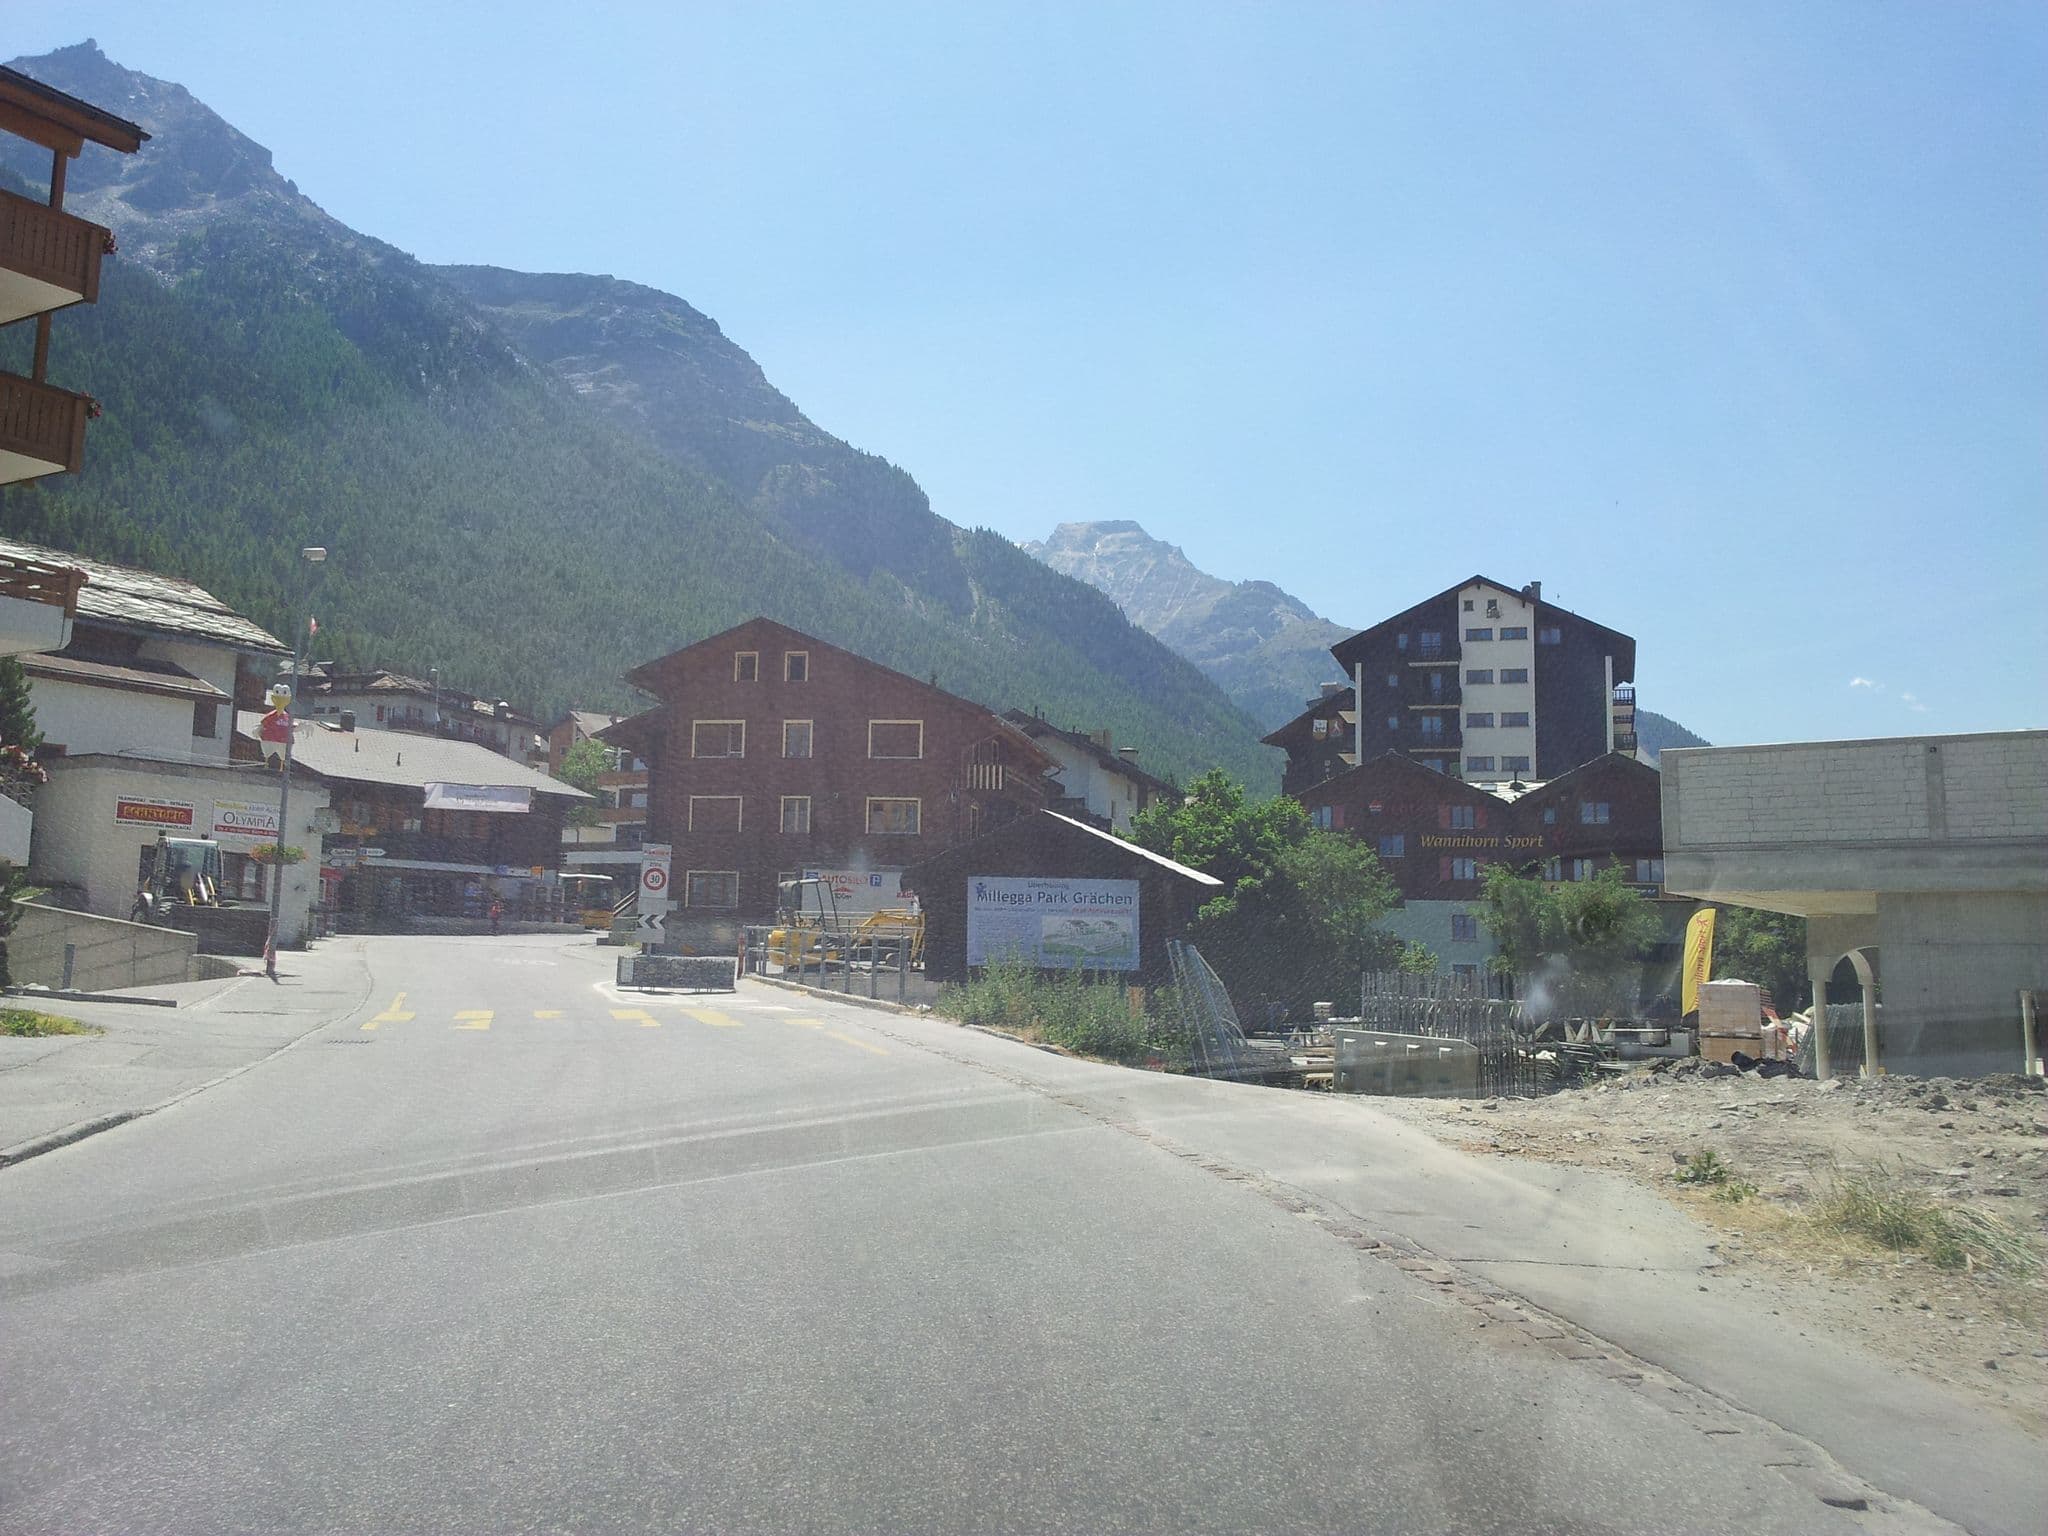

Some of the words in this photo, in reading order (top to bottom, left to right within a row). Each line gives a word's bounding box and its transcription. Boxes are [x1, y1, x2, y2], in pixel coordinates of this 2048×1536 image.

[223, 811, 276, 829] OLYMPIA
[1420, 834, 1499, 848] Wannihorn
[1503, 834, 1544, 849] Sport
[650, 874, 660, 884] 30
[977, 889, 1033, 906] Millegga
[1037, 891, 1068, 904] Park
[1073, 891, 1133, 906] Grächen
